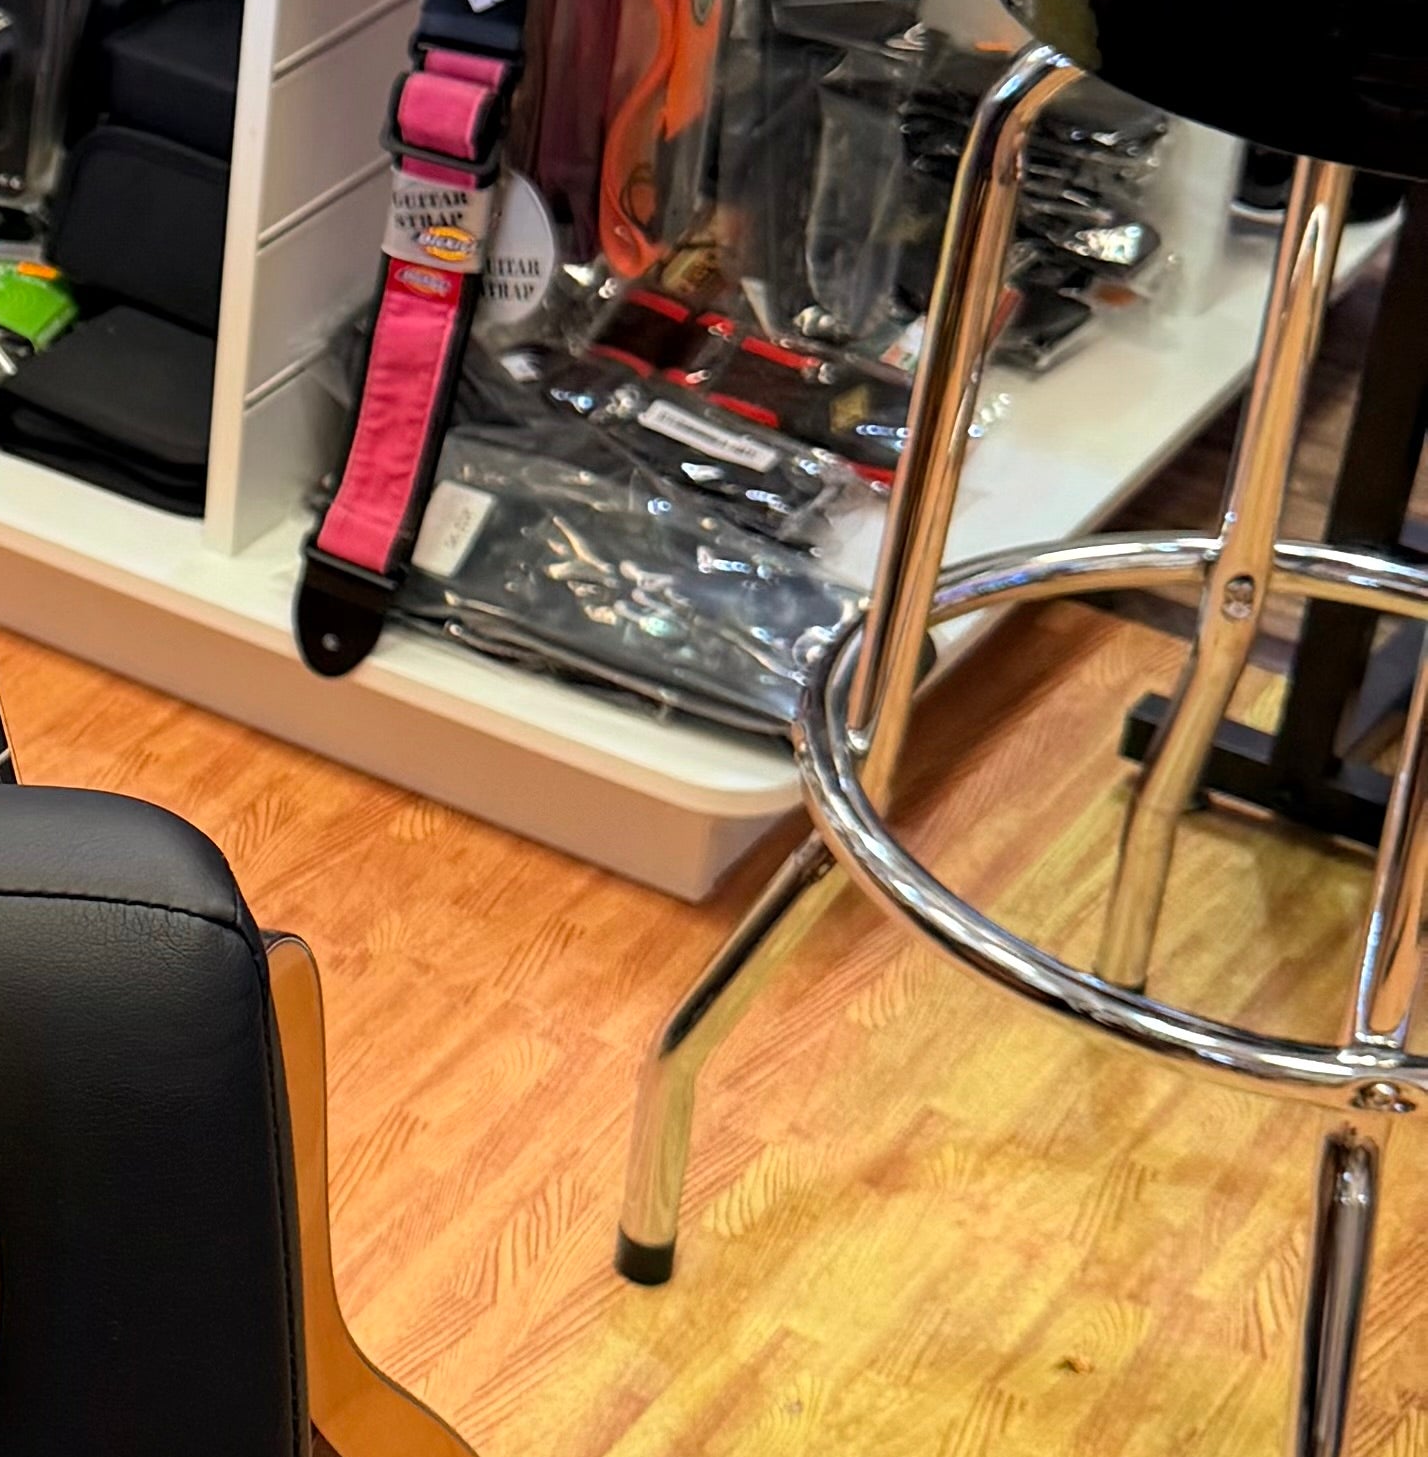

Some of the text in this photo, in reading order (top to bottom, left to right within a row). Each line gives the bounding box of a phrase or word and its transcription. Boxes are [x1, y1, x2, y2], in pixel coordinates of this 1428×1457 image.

[394, 191, 469, 210] GUITAR
[397, 211, 464, 228] STRAP
[484, 257, 541, 277] UITAR
